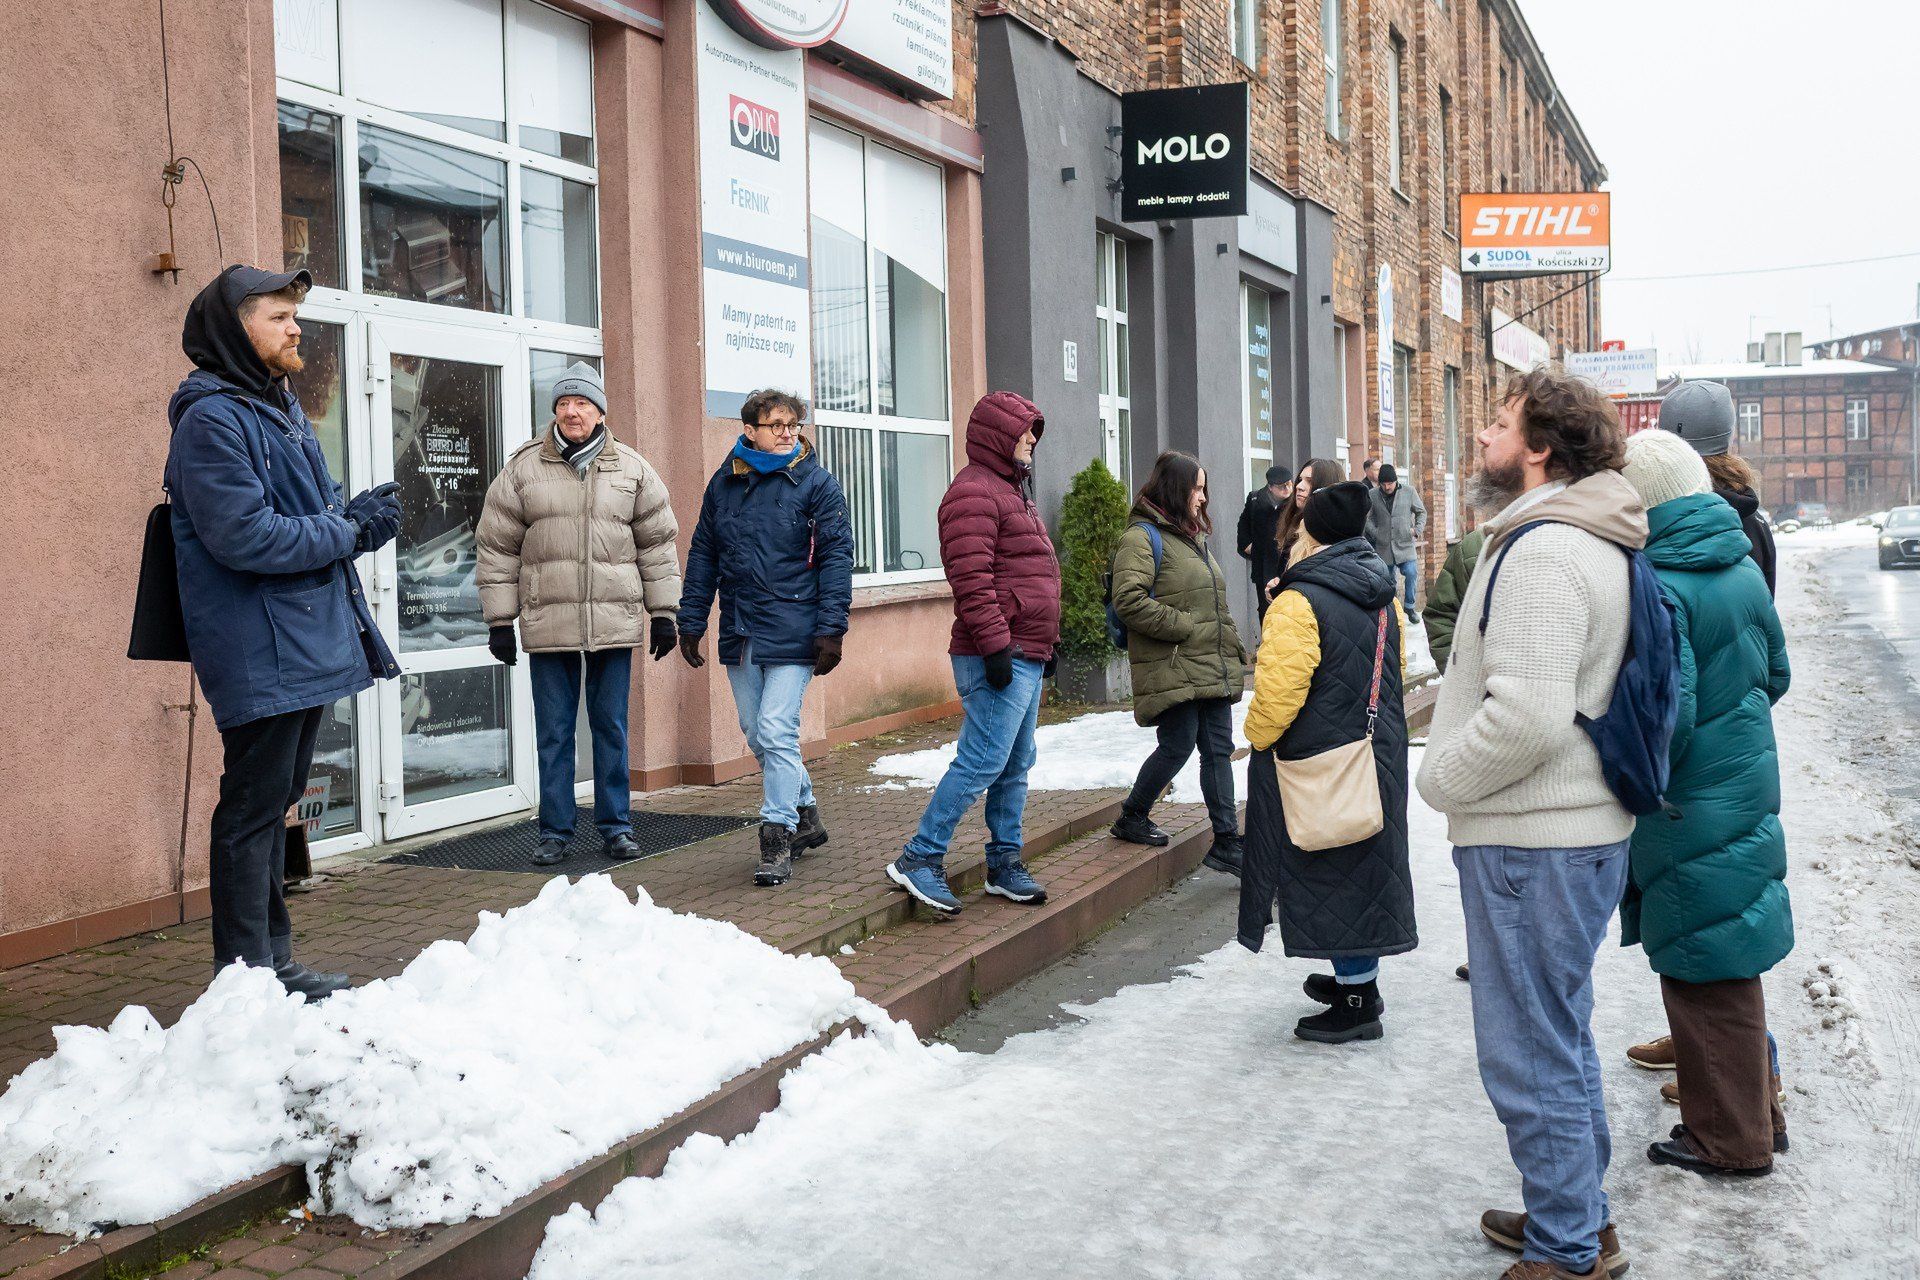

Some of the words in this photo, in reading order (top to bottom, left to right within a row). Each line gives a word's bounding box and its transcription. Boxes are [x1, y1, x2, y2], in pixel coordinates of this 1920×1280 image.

[892, 13, 924, 35] rzutniki
[925, 28, 947, 47] pisma
[705, 43, 749, 71] Autoryzowany
[749, 61, 771, 79] Partner
[771, 70, 798, 92] Handlowy
[906, 37, 947, 68] laminatory
[917, 65, 947, 88] gilotyny
[733, 102, 777, 155] OPUS
[1137, 132, 1231, 165] MOLO
[1137, 196, 1165, 206] meble
[1167, 195, 1194, 205] lampy
[1196, 191, 1230, 202] dodatki
[1471, 206, 1592, 236] STIHL
[717, 248, 797, 280] www.biuroem.pl
[1591, 257, 1604, 267] 27
[722, 303, 752, 329] Mamy
[754, 313, 784, 331] patent
[785, 319, 797, 333] na
[725, 331, 771, 352] najniższe
[772, 341, 795, 359] ceny
[1065, 344, 1077, 370] 15
[406, 604, 425, 615] OPUS
[297, 801, 324, 820] LID
